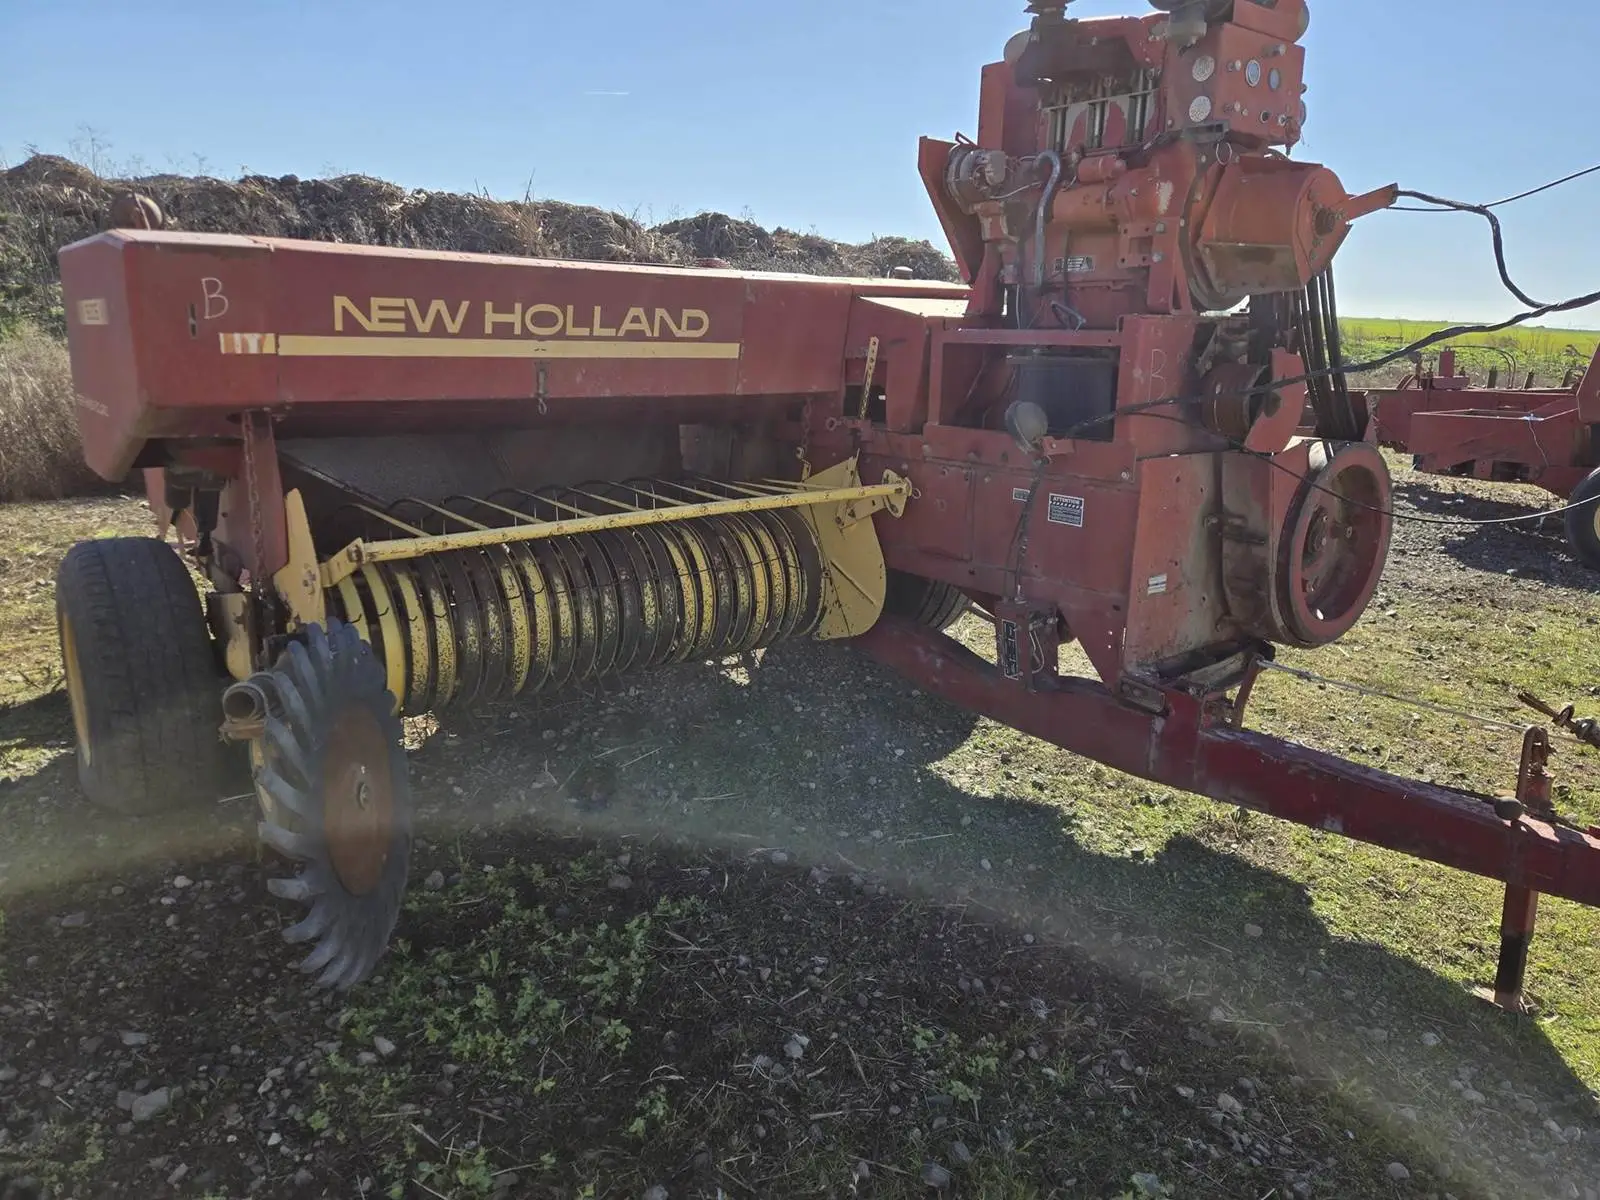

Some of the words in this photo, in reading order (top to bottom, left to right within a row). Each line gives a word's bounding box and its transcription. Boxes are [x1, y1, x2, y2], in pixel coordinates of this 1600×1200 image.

[201, 276, 229, 320] B
[333, 295, 470, 334] NEW
[484, 300, 710, 338] HOLLAND
